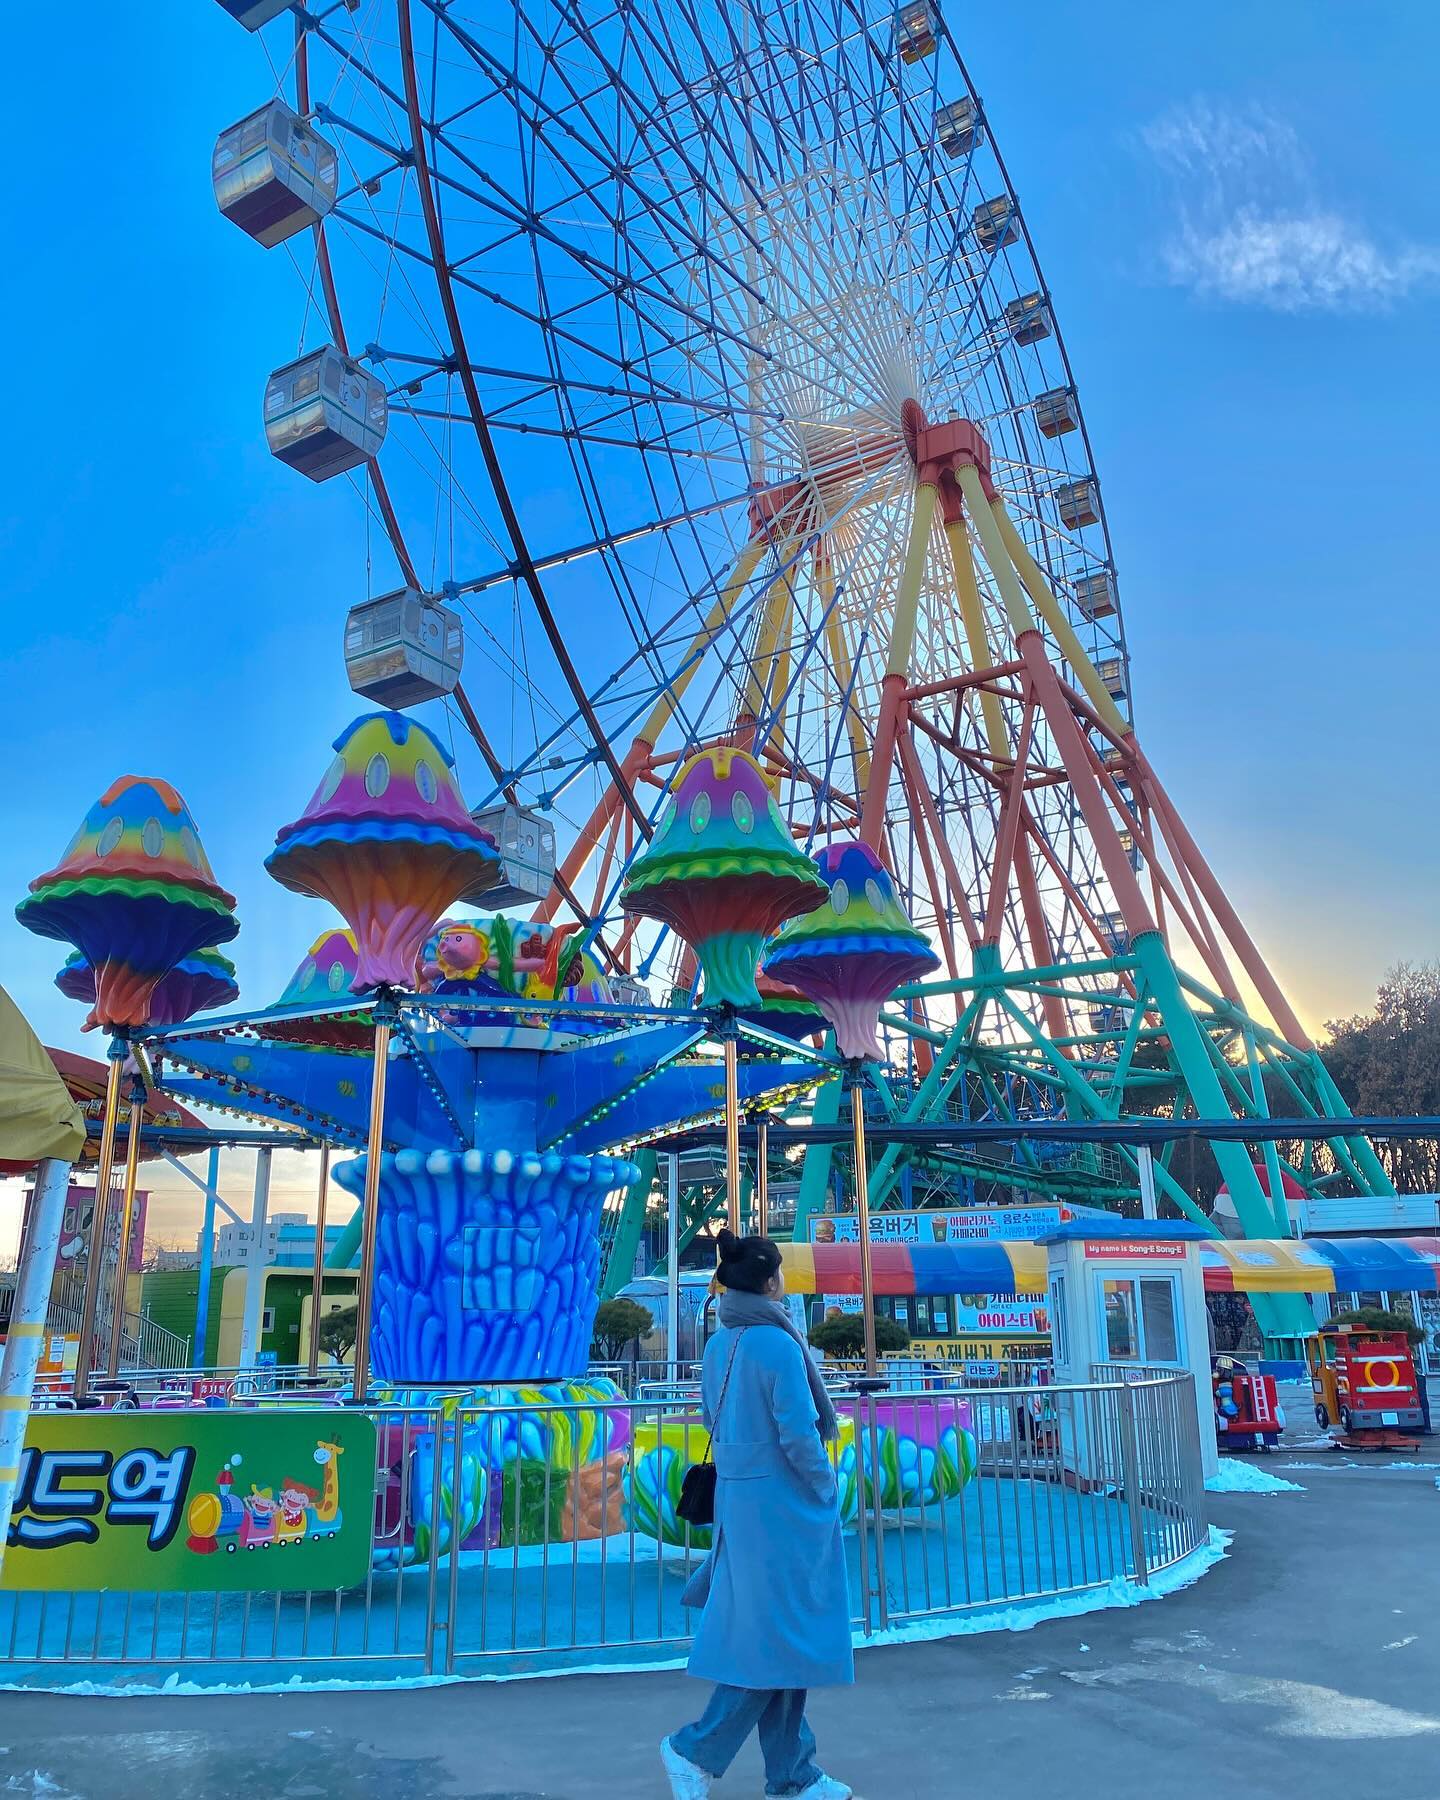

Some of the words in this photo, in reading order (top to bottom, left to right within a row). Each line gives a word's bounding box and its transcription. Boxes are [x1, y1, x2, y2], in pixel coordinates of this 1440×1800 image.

[950, 1214, 996, 1226] 아메리카노
[1003, 1213, 1031, 1225] 음료수
[951, 1227, 989, 1239] 카페라떼
[1089, 1245, 1099, 1253] My
[1129, 1245, 1154, 1254] Song-E
[1156, 1245, 1182, 1254] Song-E
[978, 1312, 1034, 1328] 아이스티
[969, 1365, 996, 1376] 타는곳
